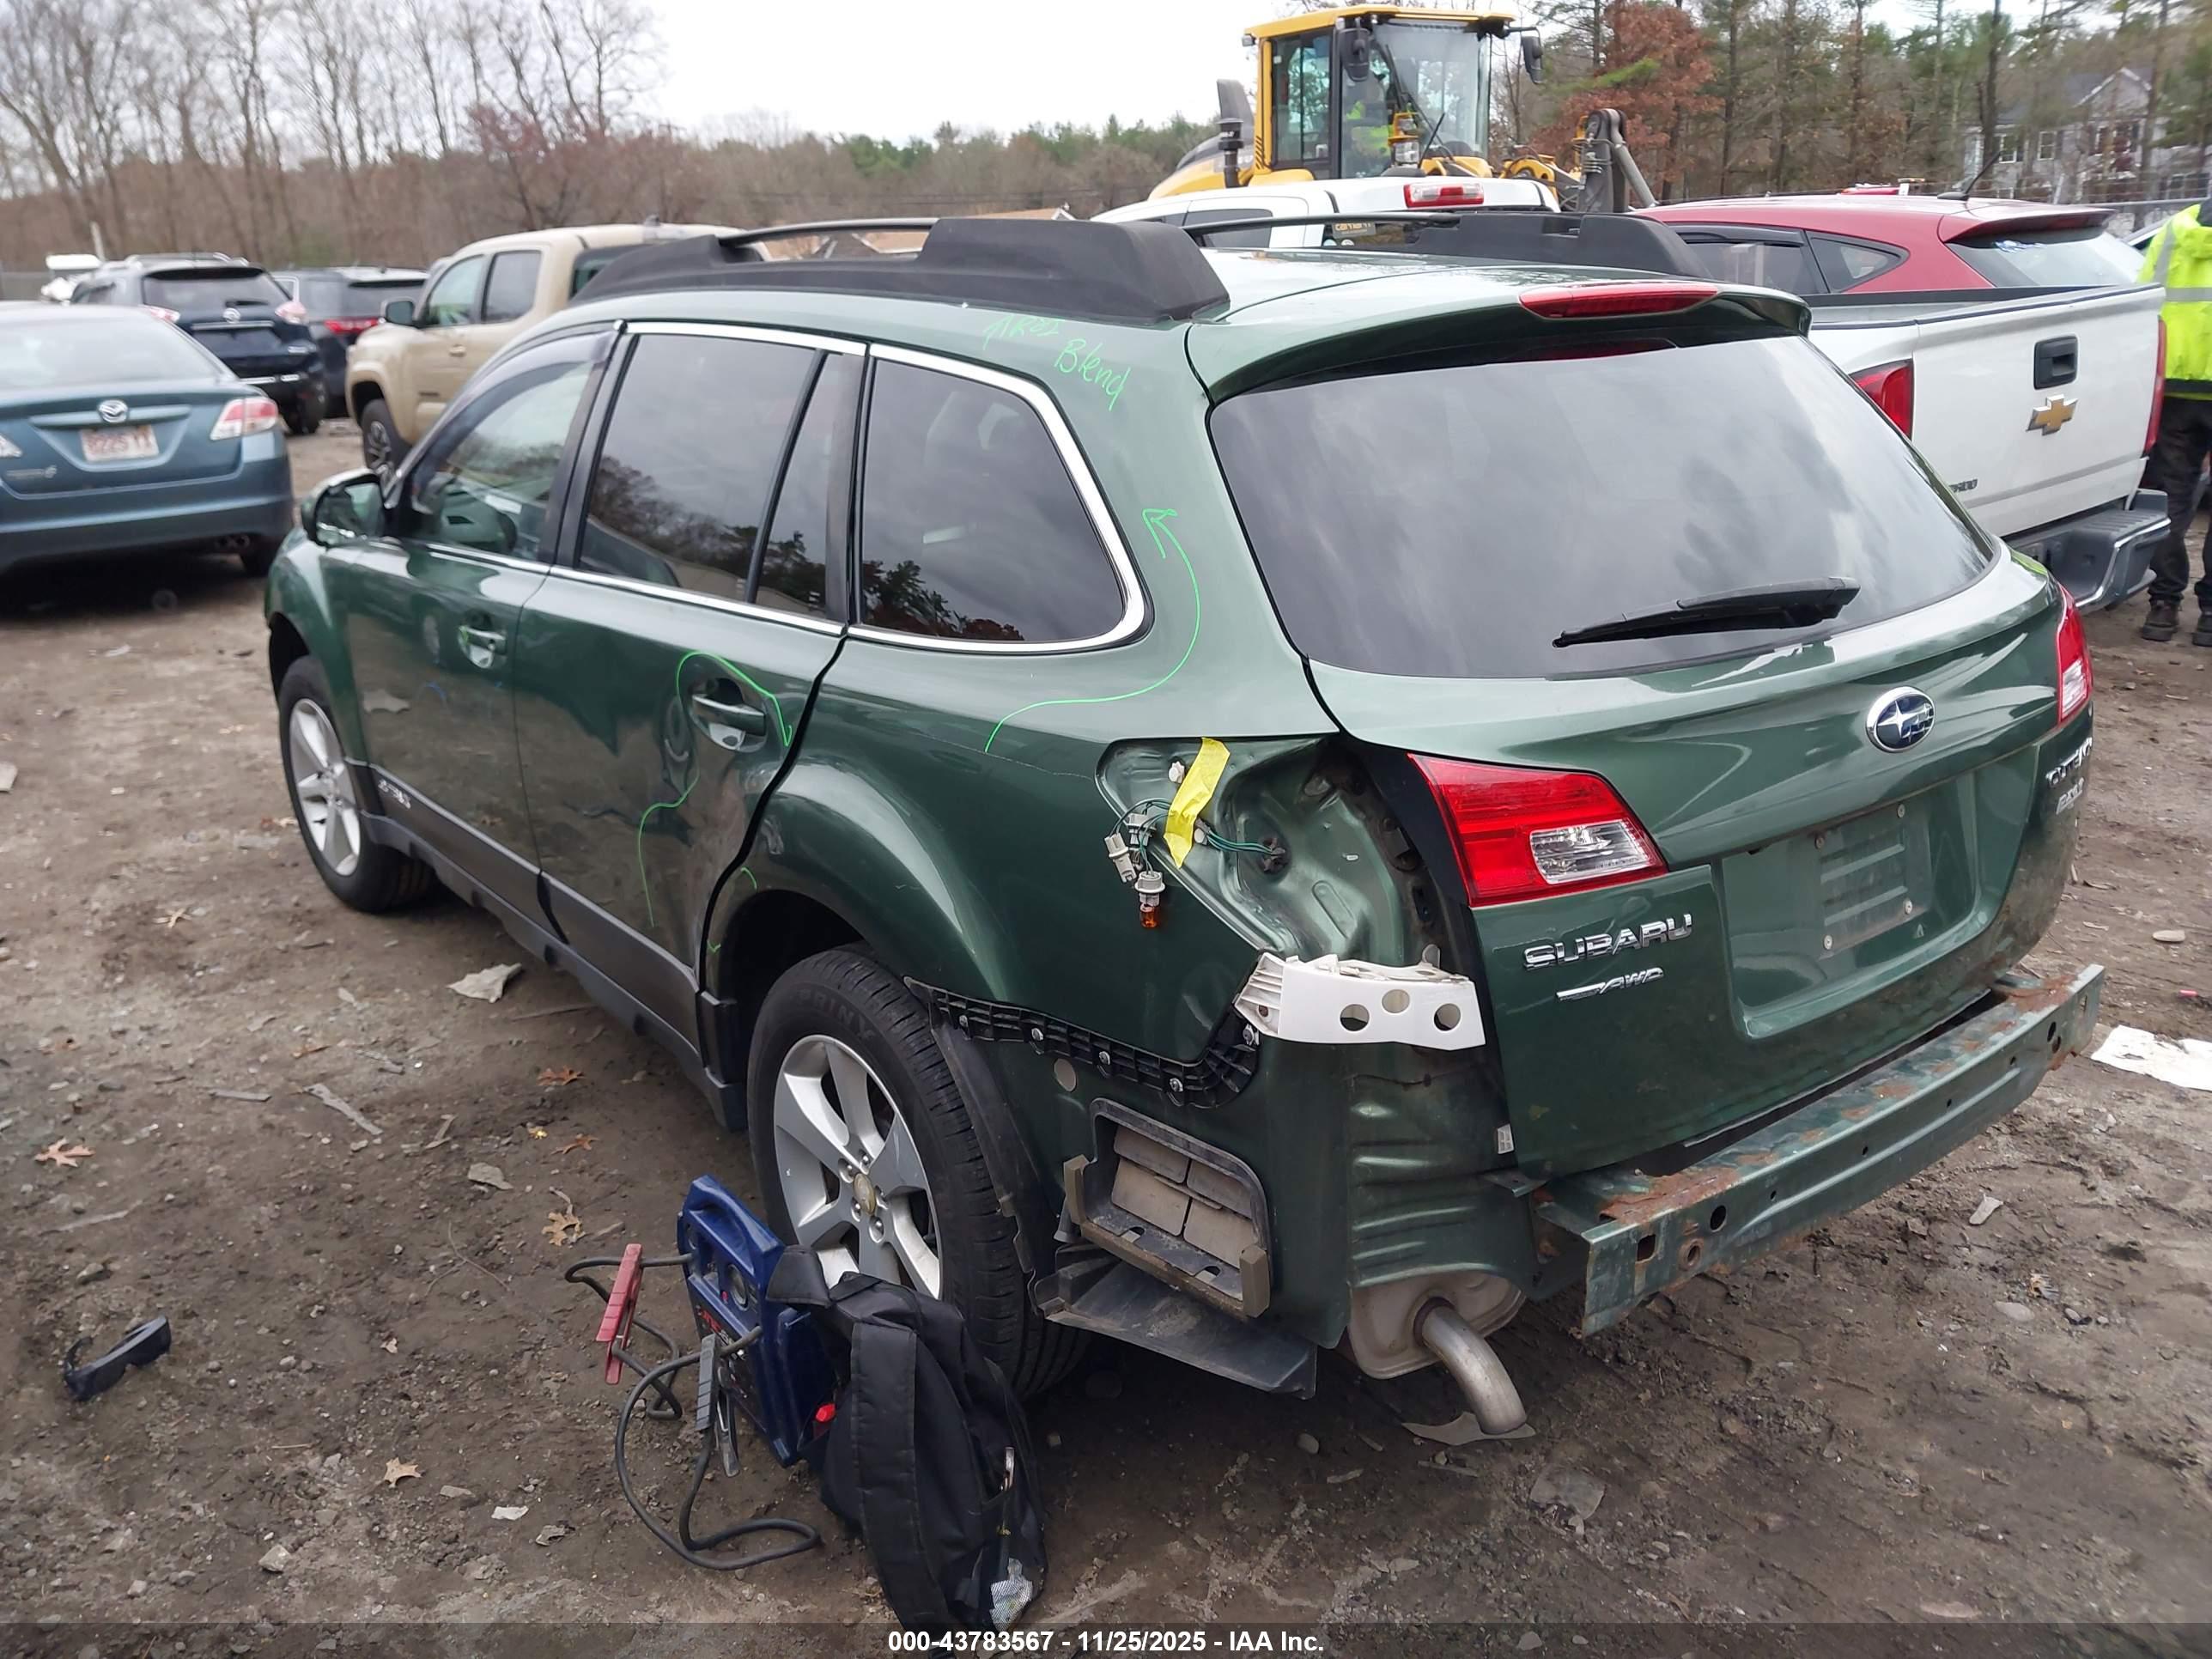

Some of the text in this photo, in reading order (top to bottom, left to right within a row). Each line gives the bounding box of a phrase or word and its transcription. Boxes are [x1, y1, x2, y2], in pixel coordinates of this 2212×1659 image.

[1054, 337, 1132, 412] Blend
[1522, 913, 1694, 971] SUBARU
[1600, 966, 1665, 994] AWD
